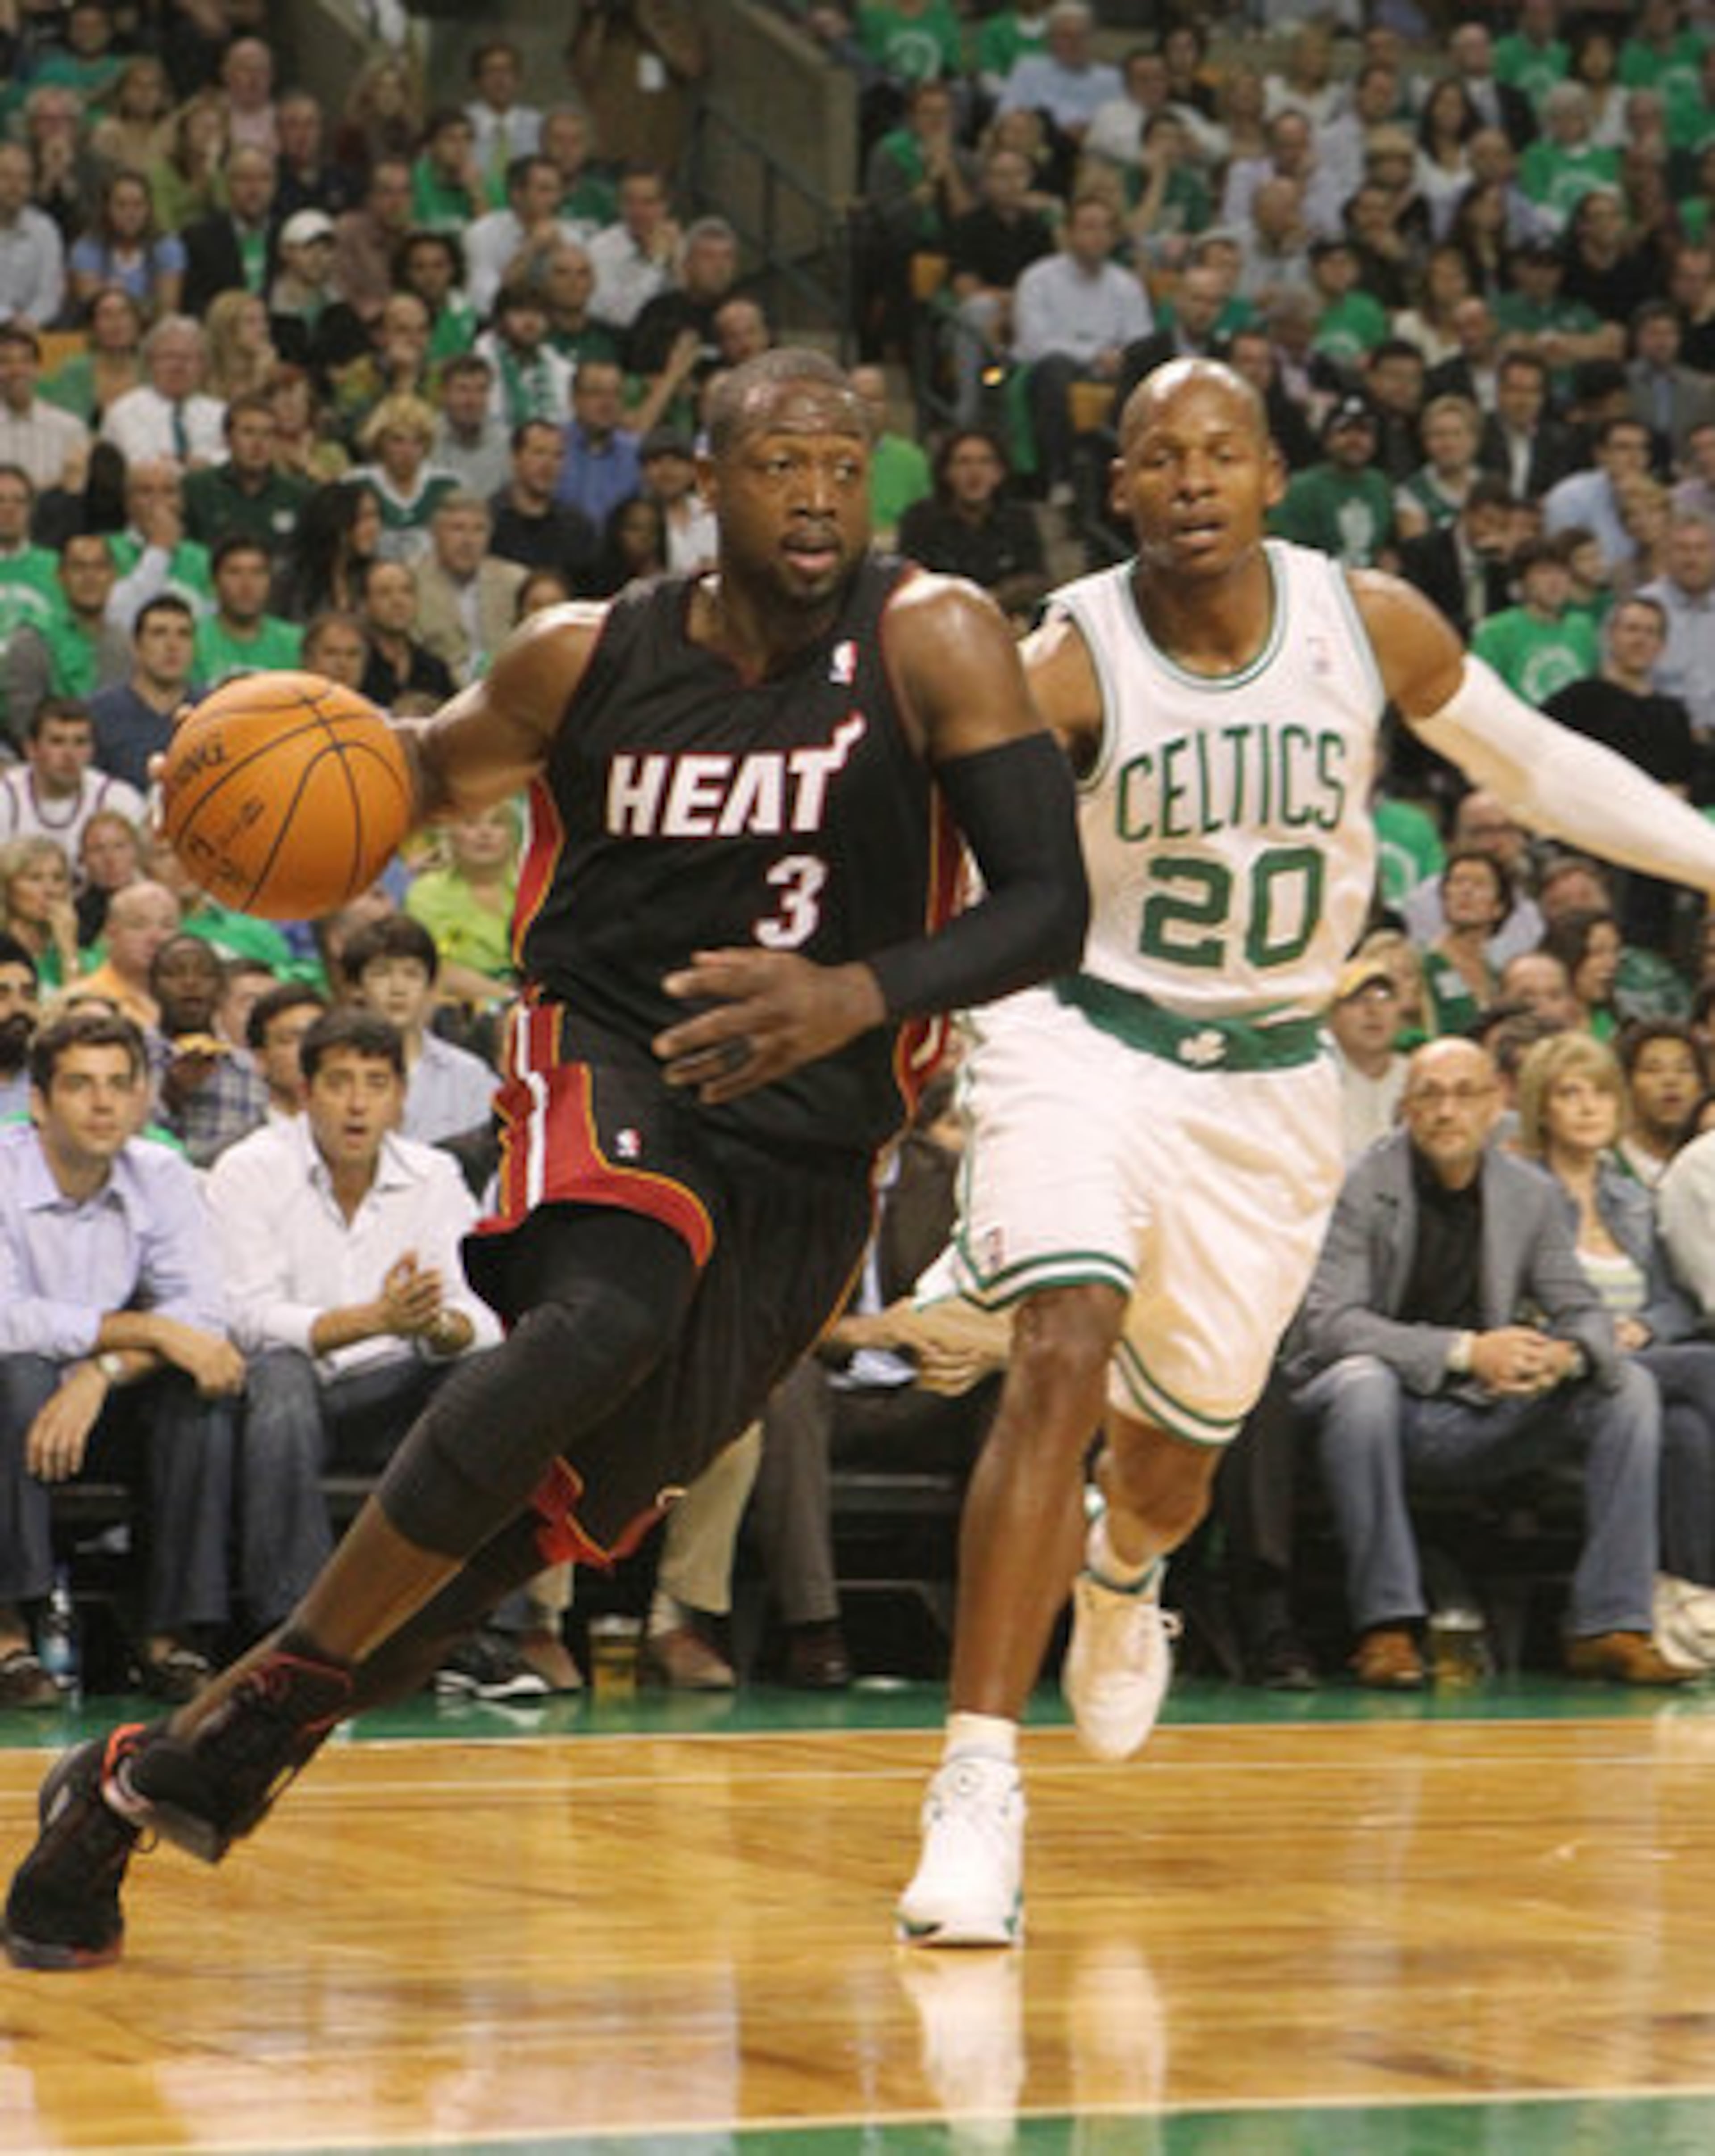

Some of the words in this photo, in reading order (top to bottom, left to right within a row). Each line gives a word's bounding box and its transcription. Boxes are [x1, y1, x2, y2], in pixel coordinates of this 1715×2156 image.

[606, 711, 866, 836] HEAT
[1117, 724, 1345, 842] CELTICS
[755, 854, 828, 950] 3
[1139, 846, 1325, 968] 20
